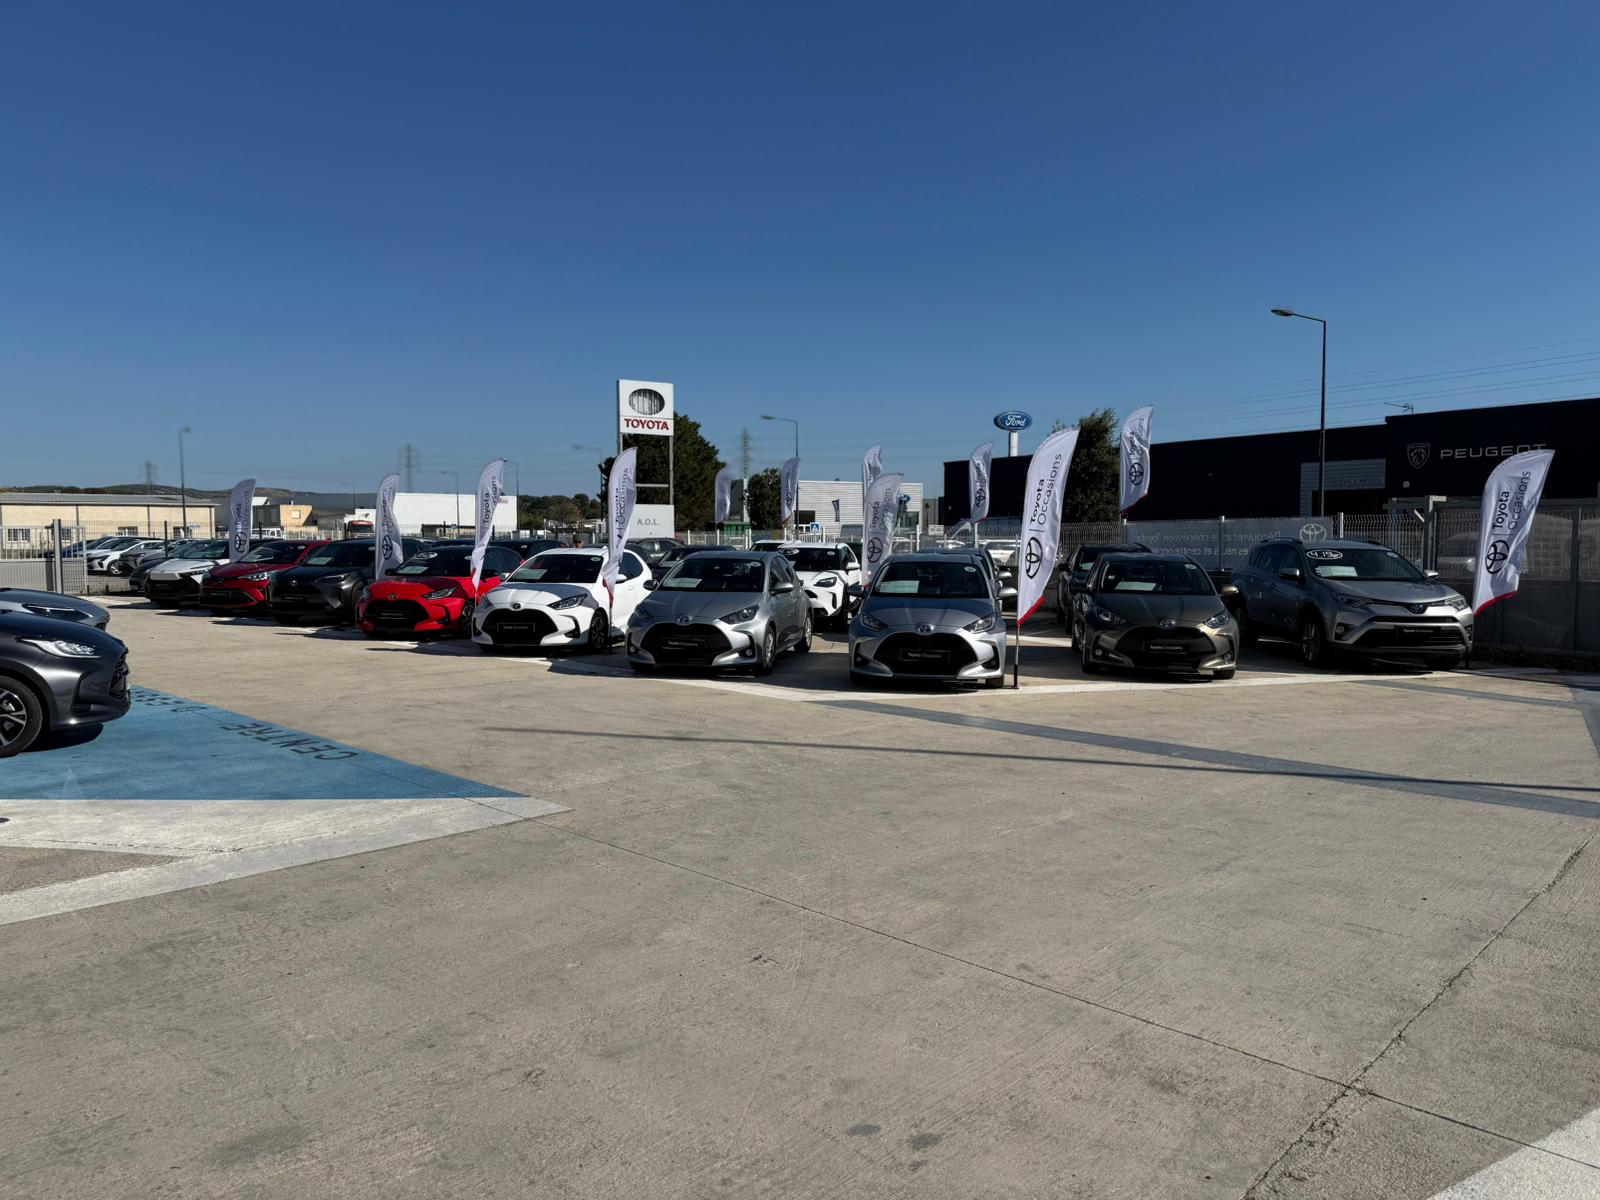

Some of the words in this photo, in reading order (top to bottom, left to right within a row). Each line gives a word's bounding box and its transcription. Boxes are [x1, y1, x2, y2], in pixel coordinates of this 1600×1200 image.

[624, 418, 670, 431] TOYOTA
[1005, 415, 1027, 427] Ford
[482, 492, 491, 525] Toyota
[618, 467, 629, 526] Occasions
[1030, 479, 1045, 525] Toyota
[1037, 454, 1062, 526] Occasions
[1508, 470, 1532, 530] Occasions
[870, 502, 880, 529] Toyota
[1492, 491, 1511, 530] Toyota
[220, 723, 359, 761] CENTRE
